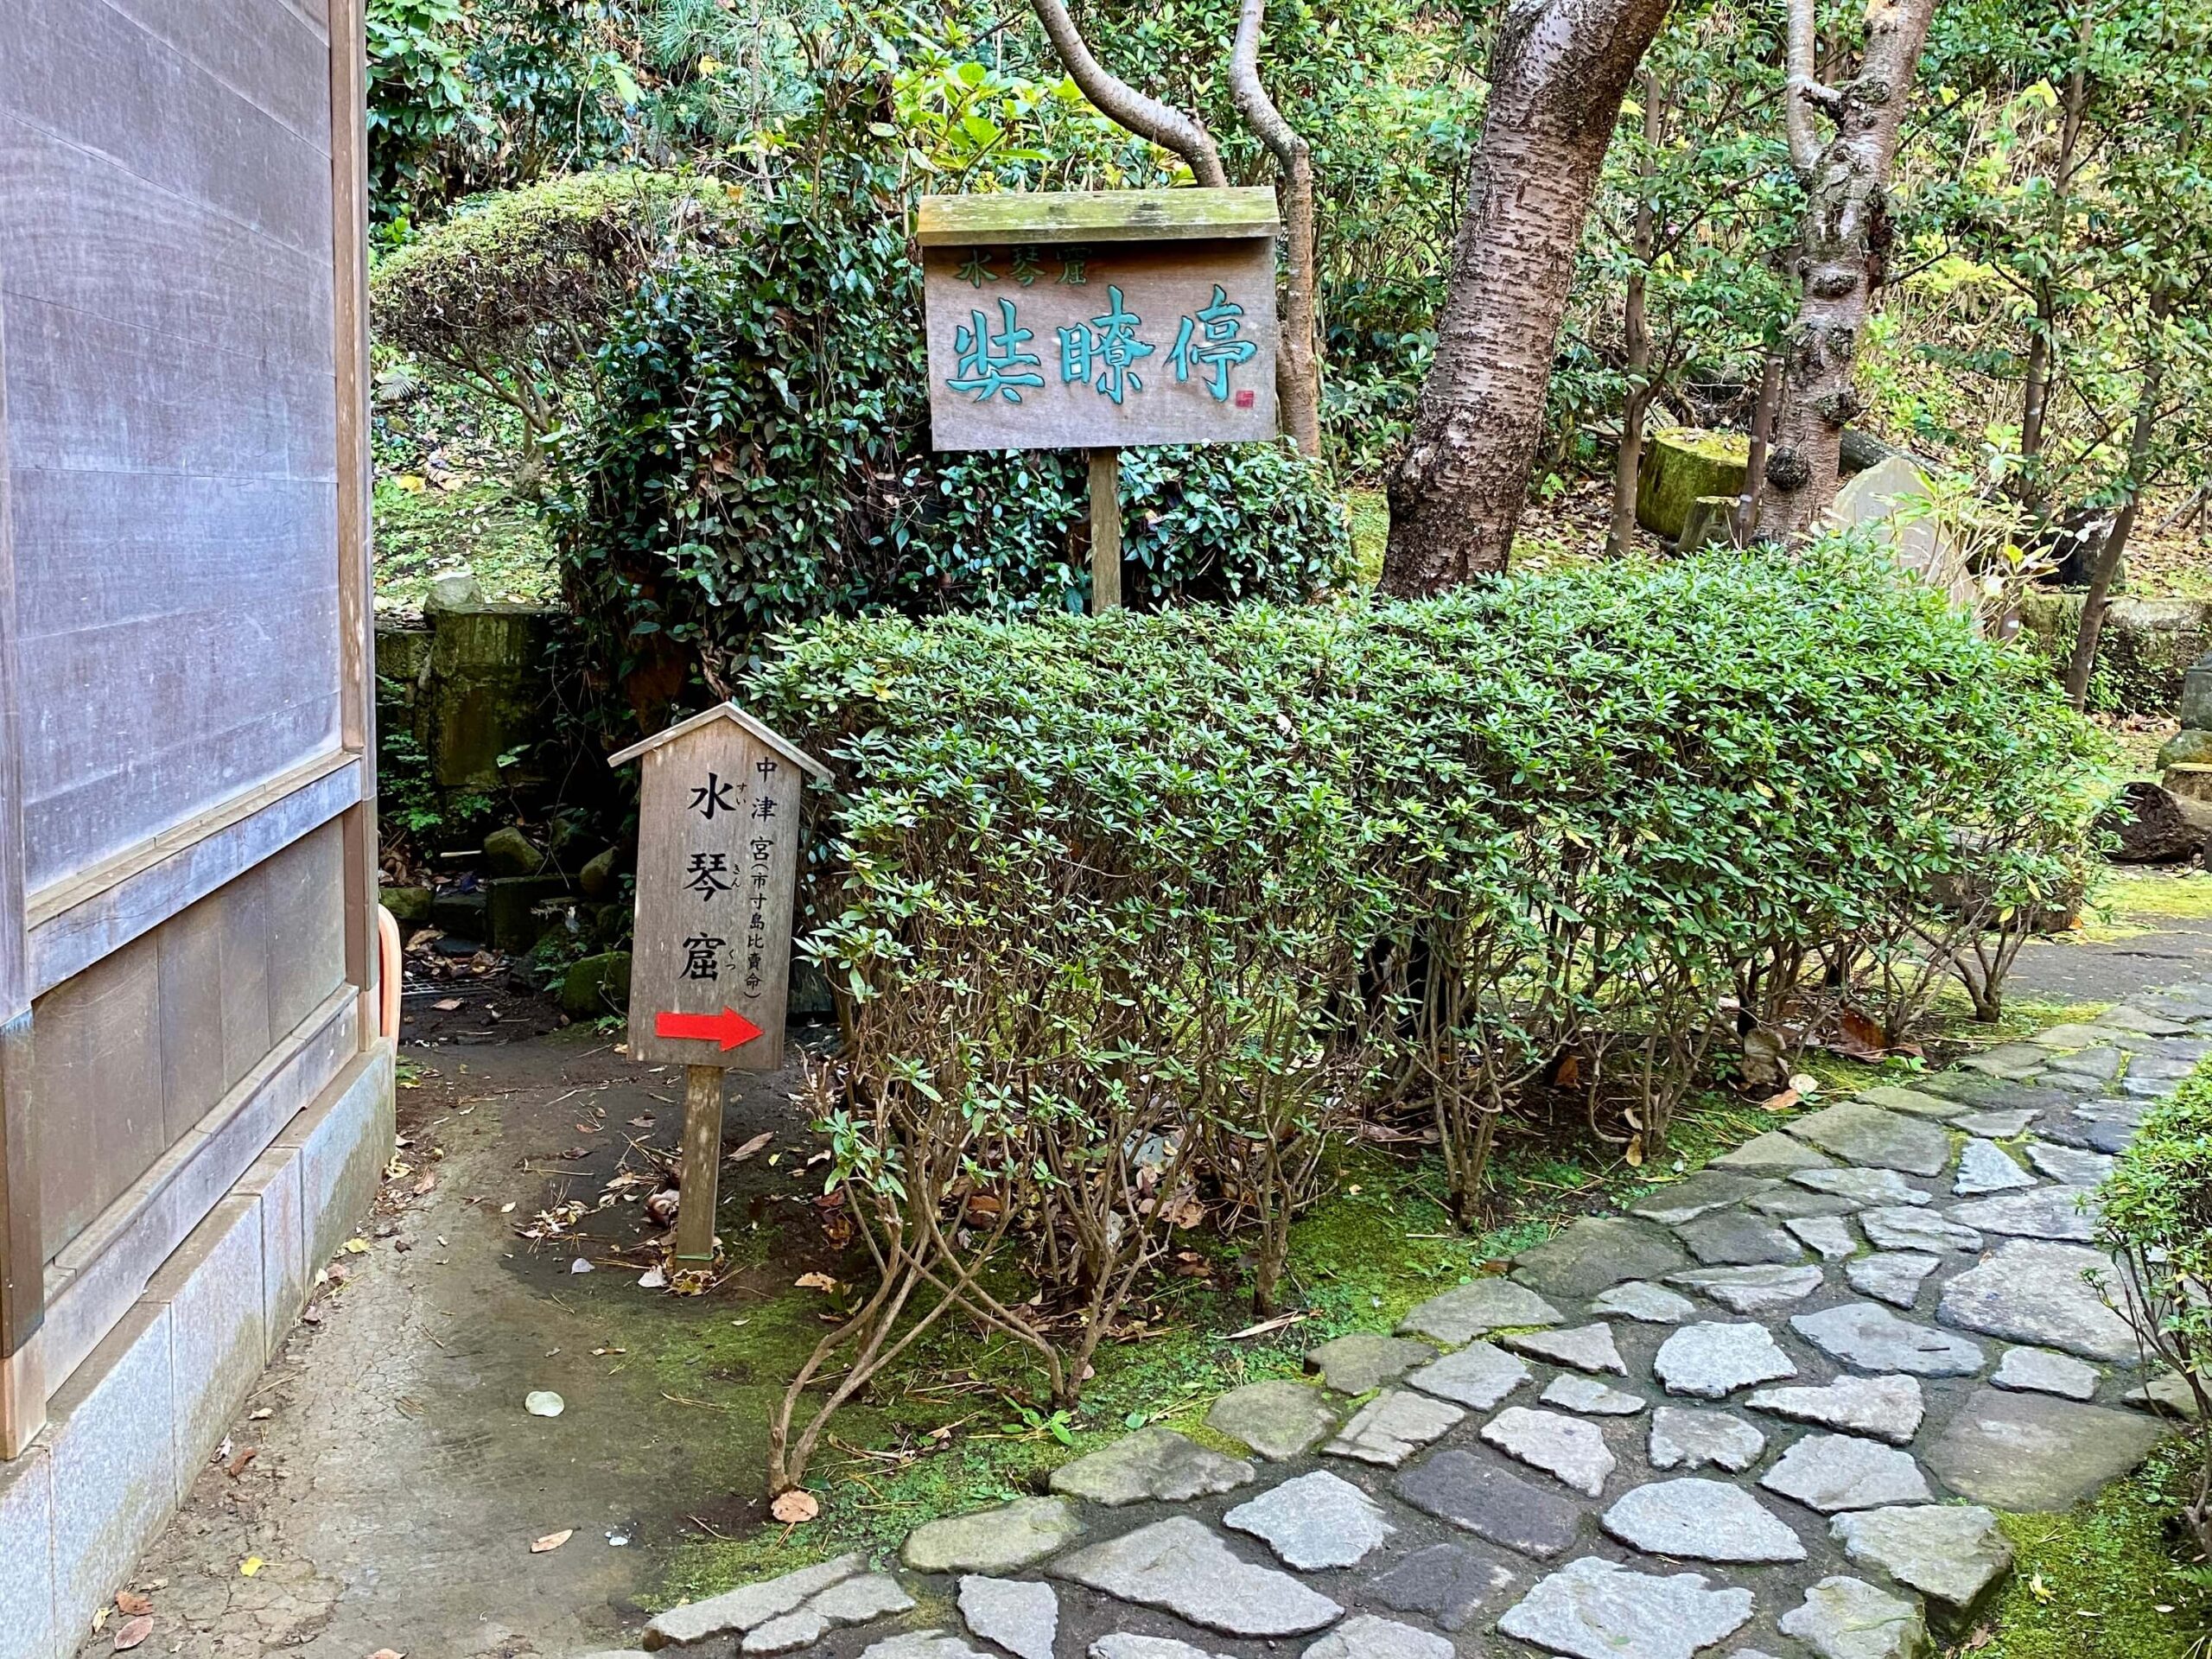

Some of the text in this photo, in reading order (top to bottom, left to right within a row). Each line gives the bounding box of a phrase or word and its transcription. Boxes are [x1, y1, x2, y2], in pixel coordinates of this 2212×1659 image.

[954, 246, 1092, 289] 水琴窟
[678, 772, 737, 982] 水琴窟
